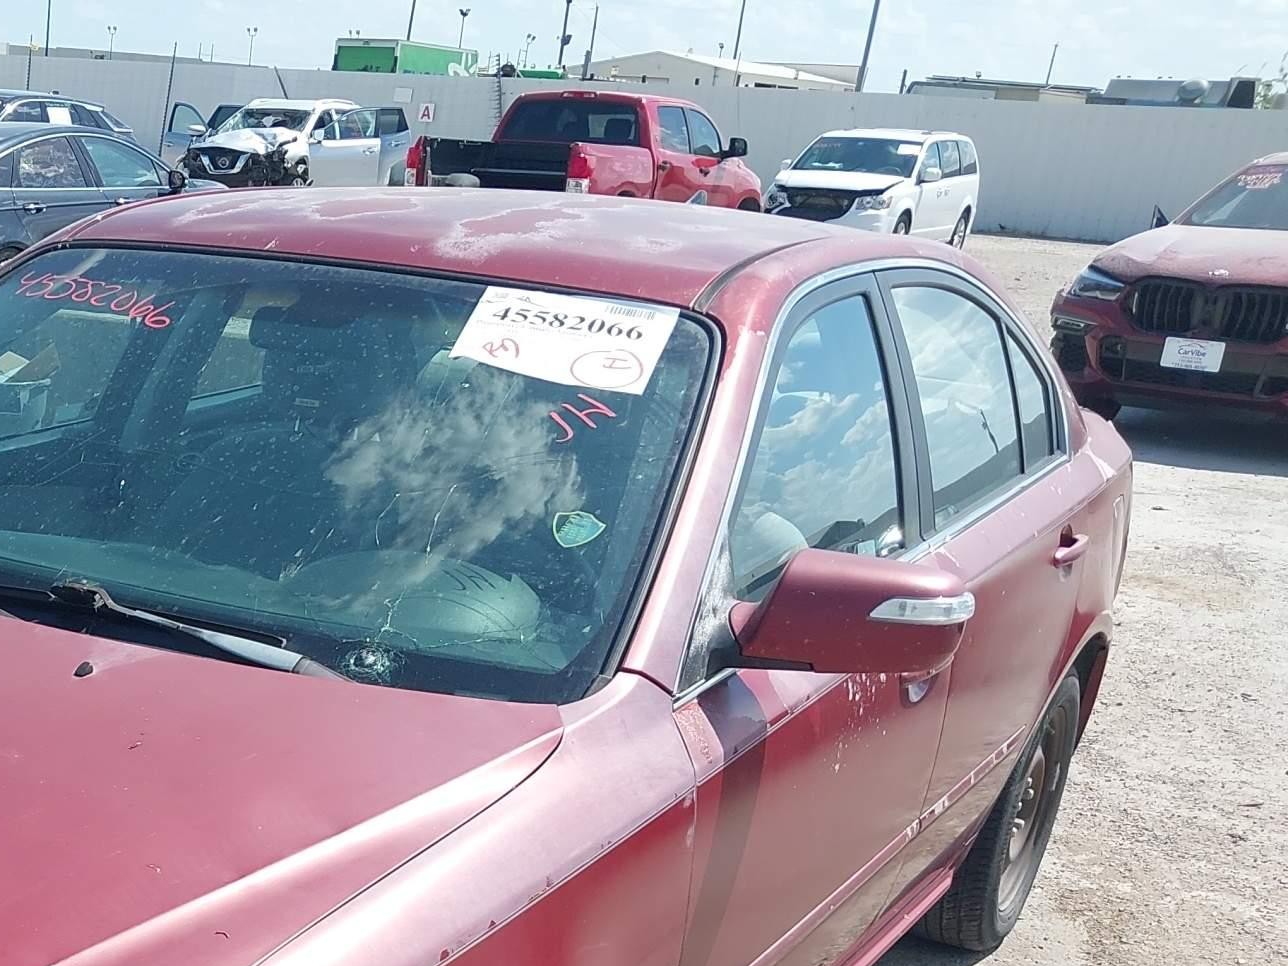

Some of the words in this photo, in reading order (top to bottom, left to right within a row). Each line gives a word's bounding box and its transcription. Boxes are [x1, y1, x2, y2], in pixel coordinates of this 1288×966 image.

[421, 105, 431, 120] A
[15, 271, 176, 328] 45582066
[492, 307, 643, 341] 45582066
[1177, 347, 1208, 358] CarVibe
[549, 394, 617, 443] JH
